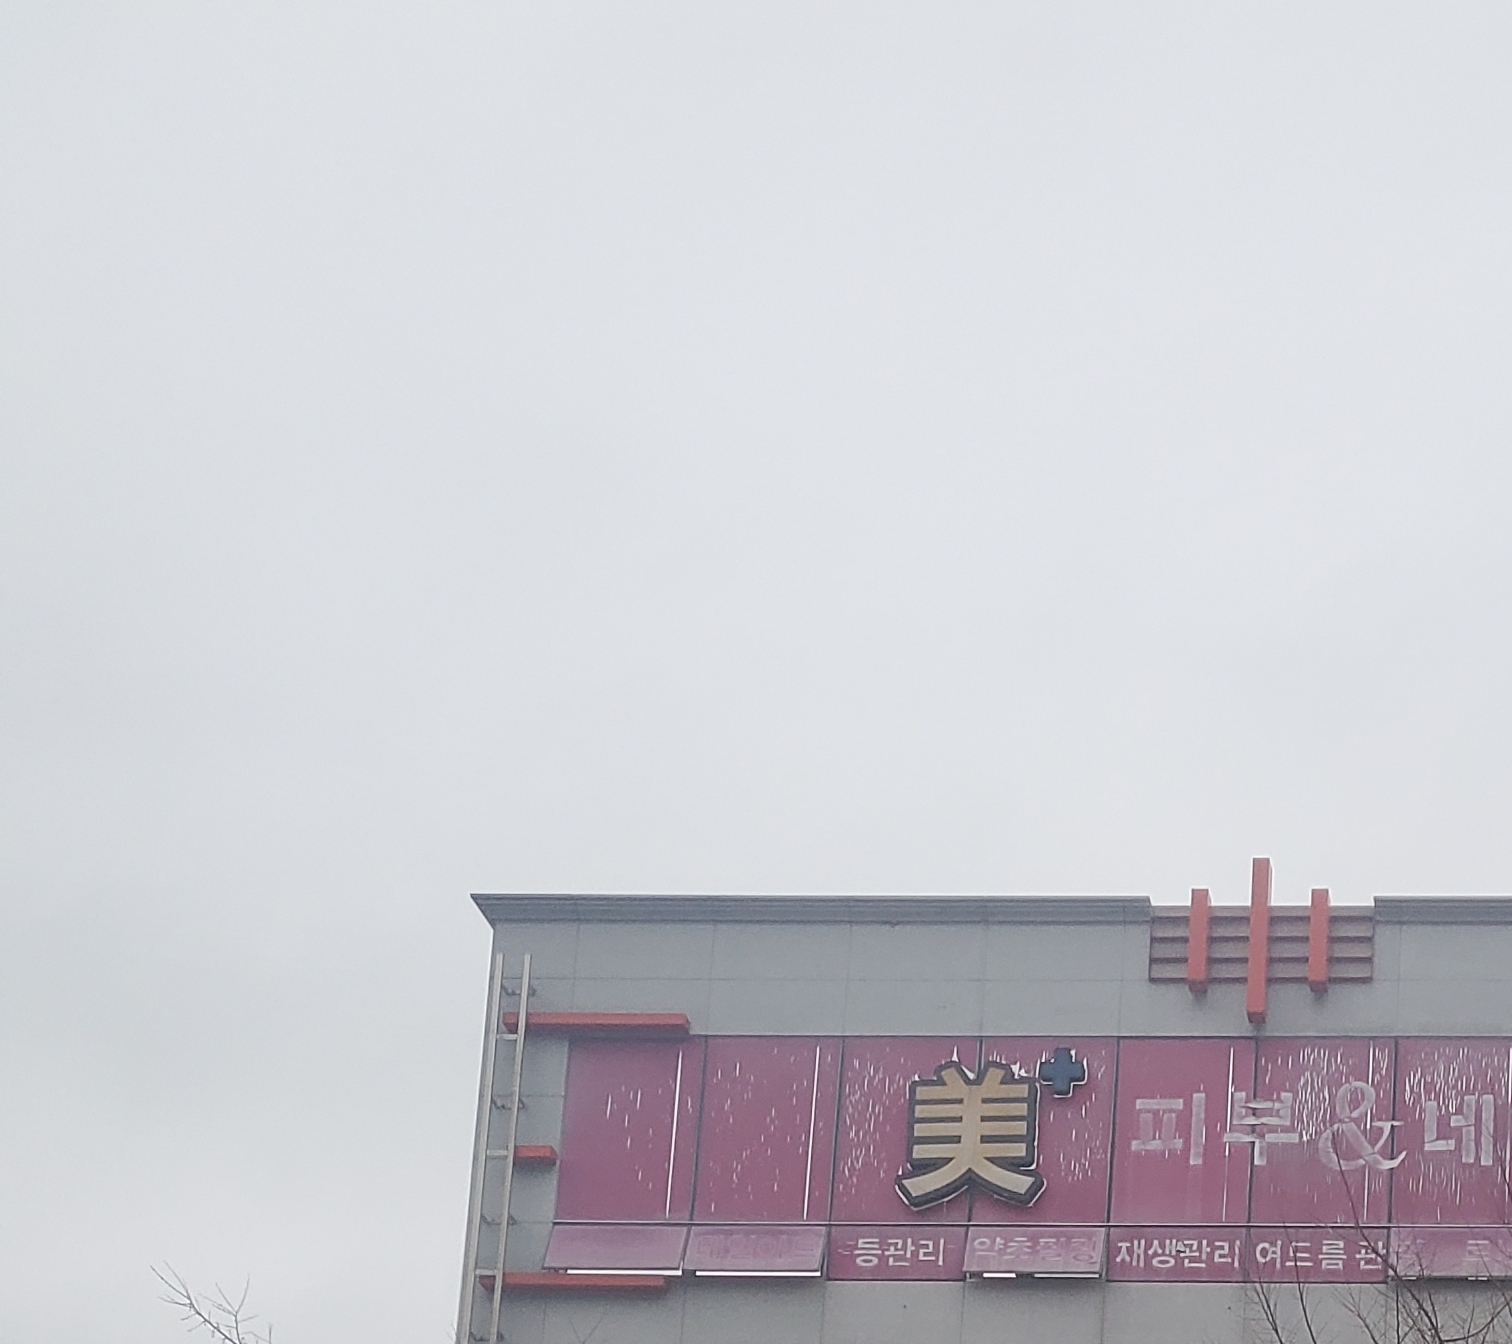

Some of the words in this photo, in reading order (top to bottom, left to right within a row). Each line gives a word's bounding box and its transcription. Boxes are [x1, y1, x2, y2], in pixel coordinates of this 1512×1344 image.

[896, 1062, 1046, 1208] 美
[1114, 1238, 1241, 1269] 재생관리
[1255, 1239, 1348, 1270] 여드름
